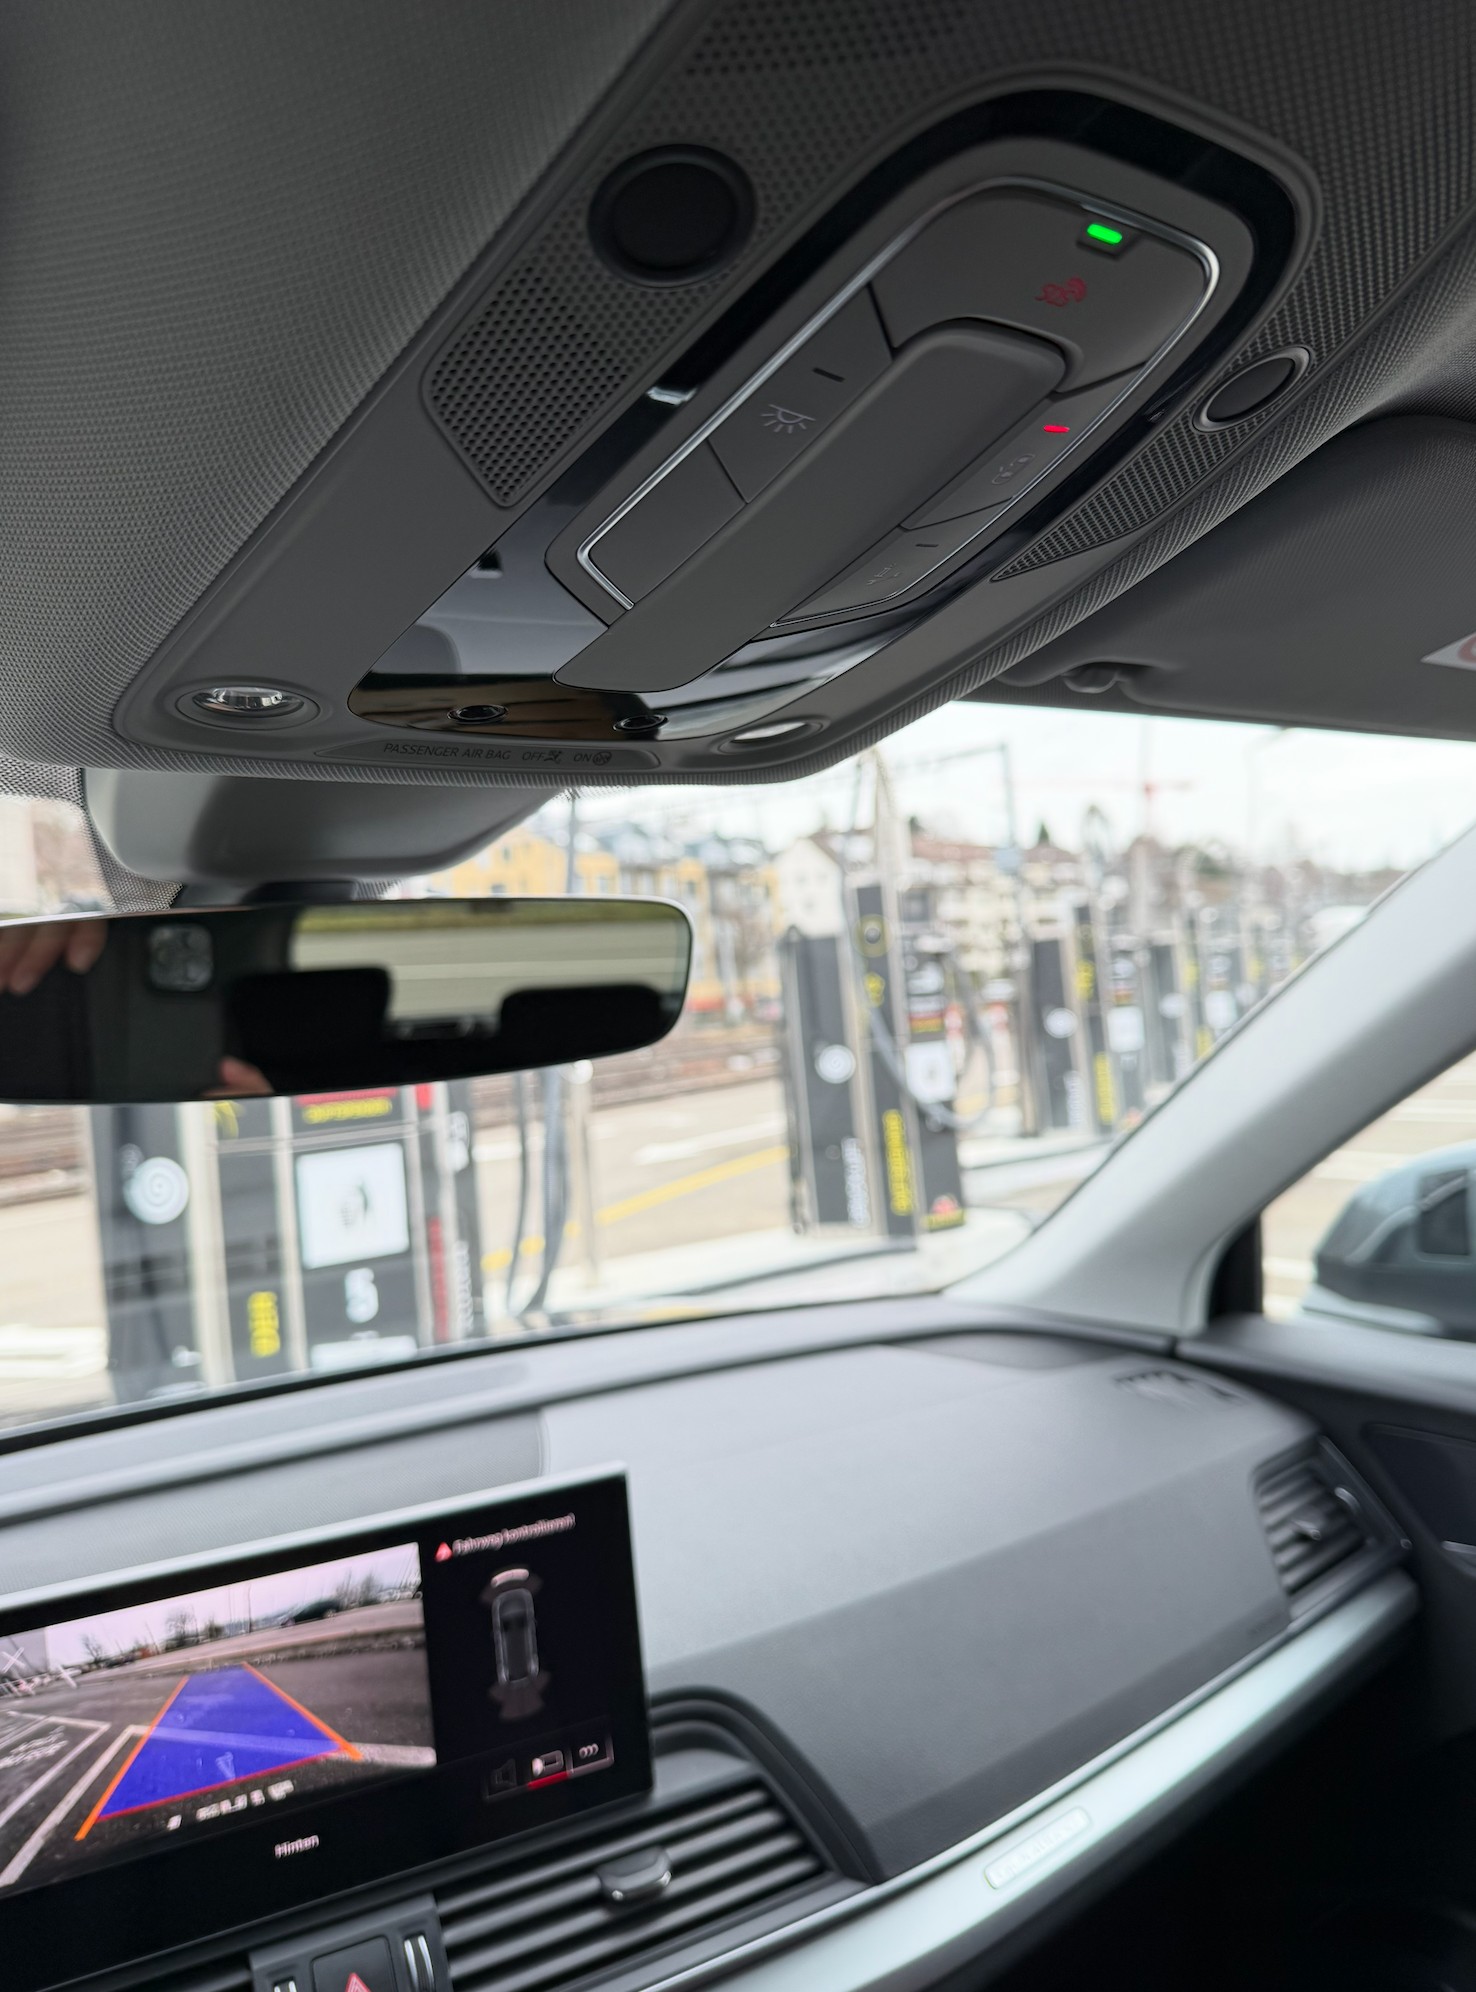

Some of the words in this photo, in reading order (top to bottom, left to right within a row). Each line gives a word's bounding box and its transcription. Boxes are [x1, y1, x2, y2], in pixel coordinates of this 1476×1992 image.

[383, 743, 460, 757] PASSENGER
[462, 748, 483, 759] AIR
[485, 749, 511, 760] BAG
[522, 751, 545, 761] OFF
[573, 753, 593, 762] ON
[274, 1834, 320, 1859] Hinten
